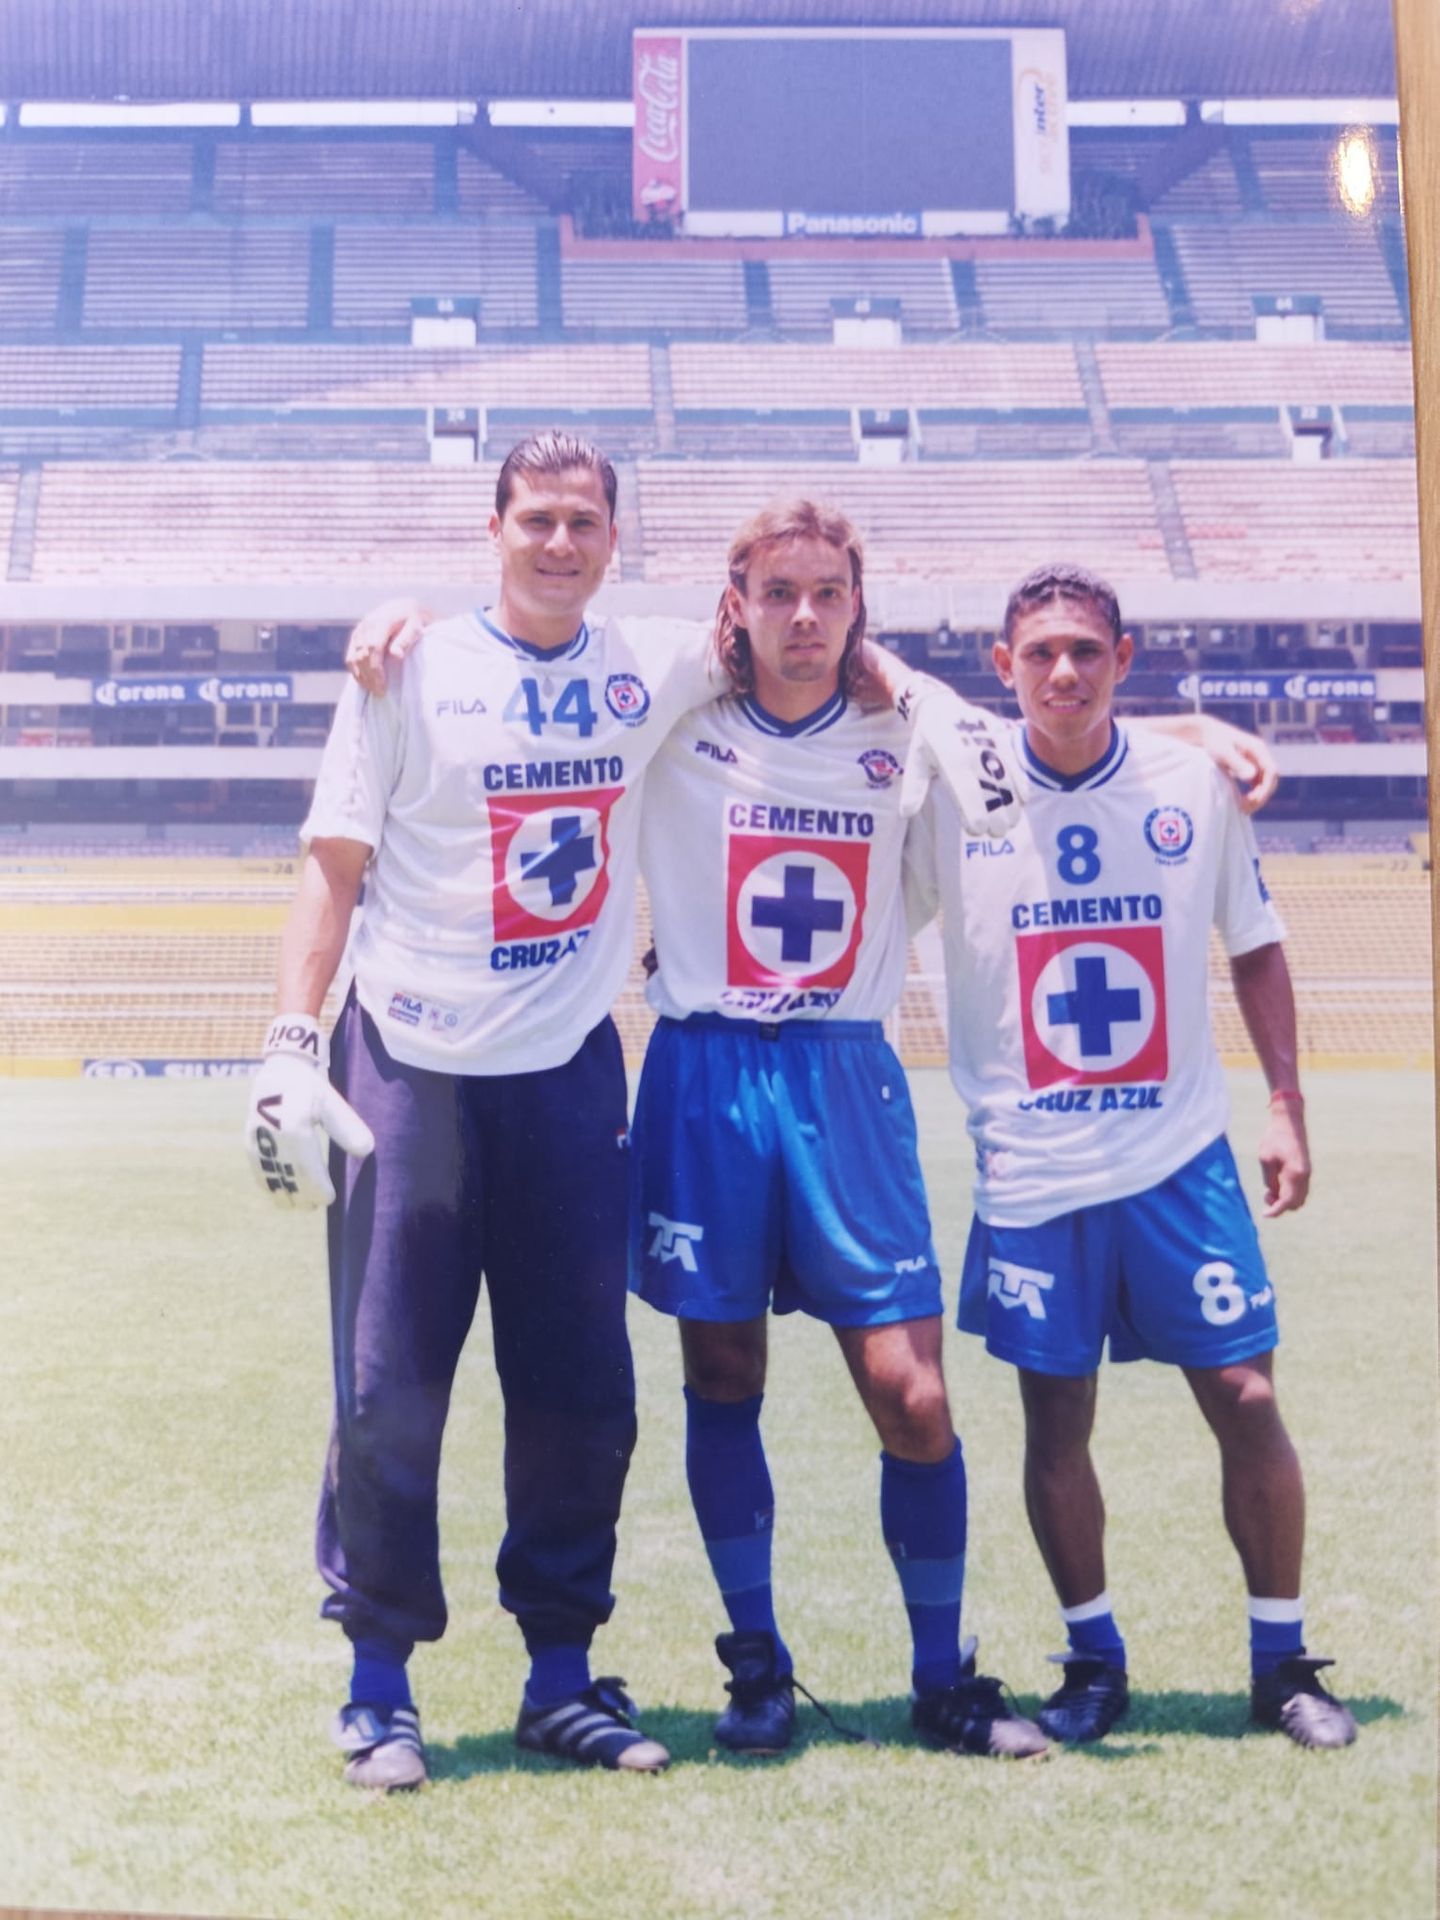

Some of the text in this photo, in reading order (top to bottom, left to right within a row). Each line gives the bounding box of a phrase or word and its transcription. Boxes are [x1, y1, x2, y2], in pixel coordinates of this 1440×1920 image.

[787, 211, 917, 234] Panasonic
[96, 678, 288, 706] Corona Corona
[1177, 675, 1374, 699] Corona Corona
[436, 699, 488, 718] FILA
[502, 677, 598, 737] 44
[695, 740, 738, 764] FILA
[483, 756, 623, 791] CEMENTO
[729, 803, 874, 837] CEMENTO
[966, 839, 1015, 859] FILA
[1056, 824, 1102, 885] 8
[1012, 894, 1163, 928] CEMENTO
[490, 939, 561, 971] CRUZ
[1099, 1086, 1163, 1112] AZUL
[1192, 1261, 1246, 1325] 8
